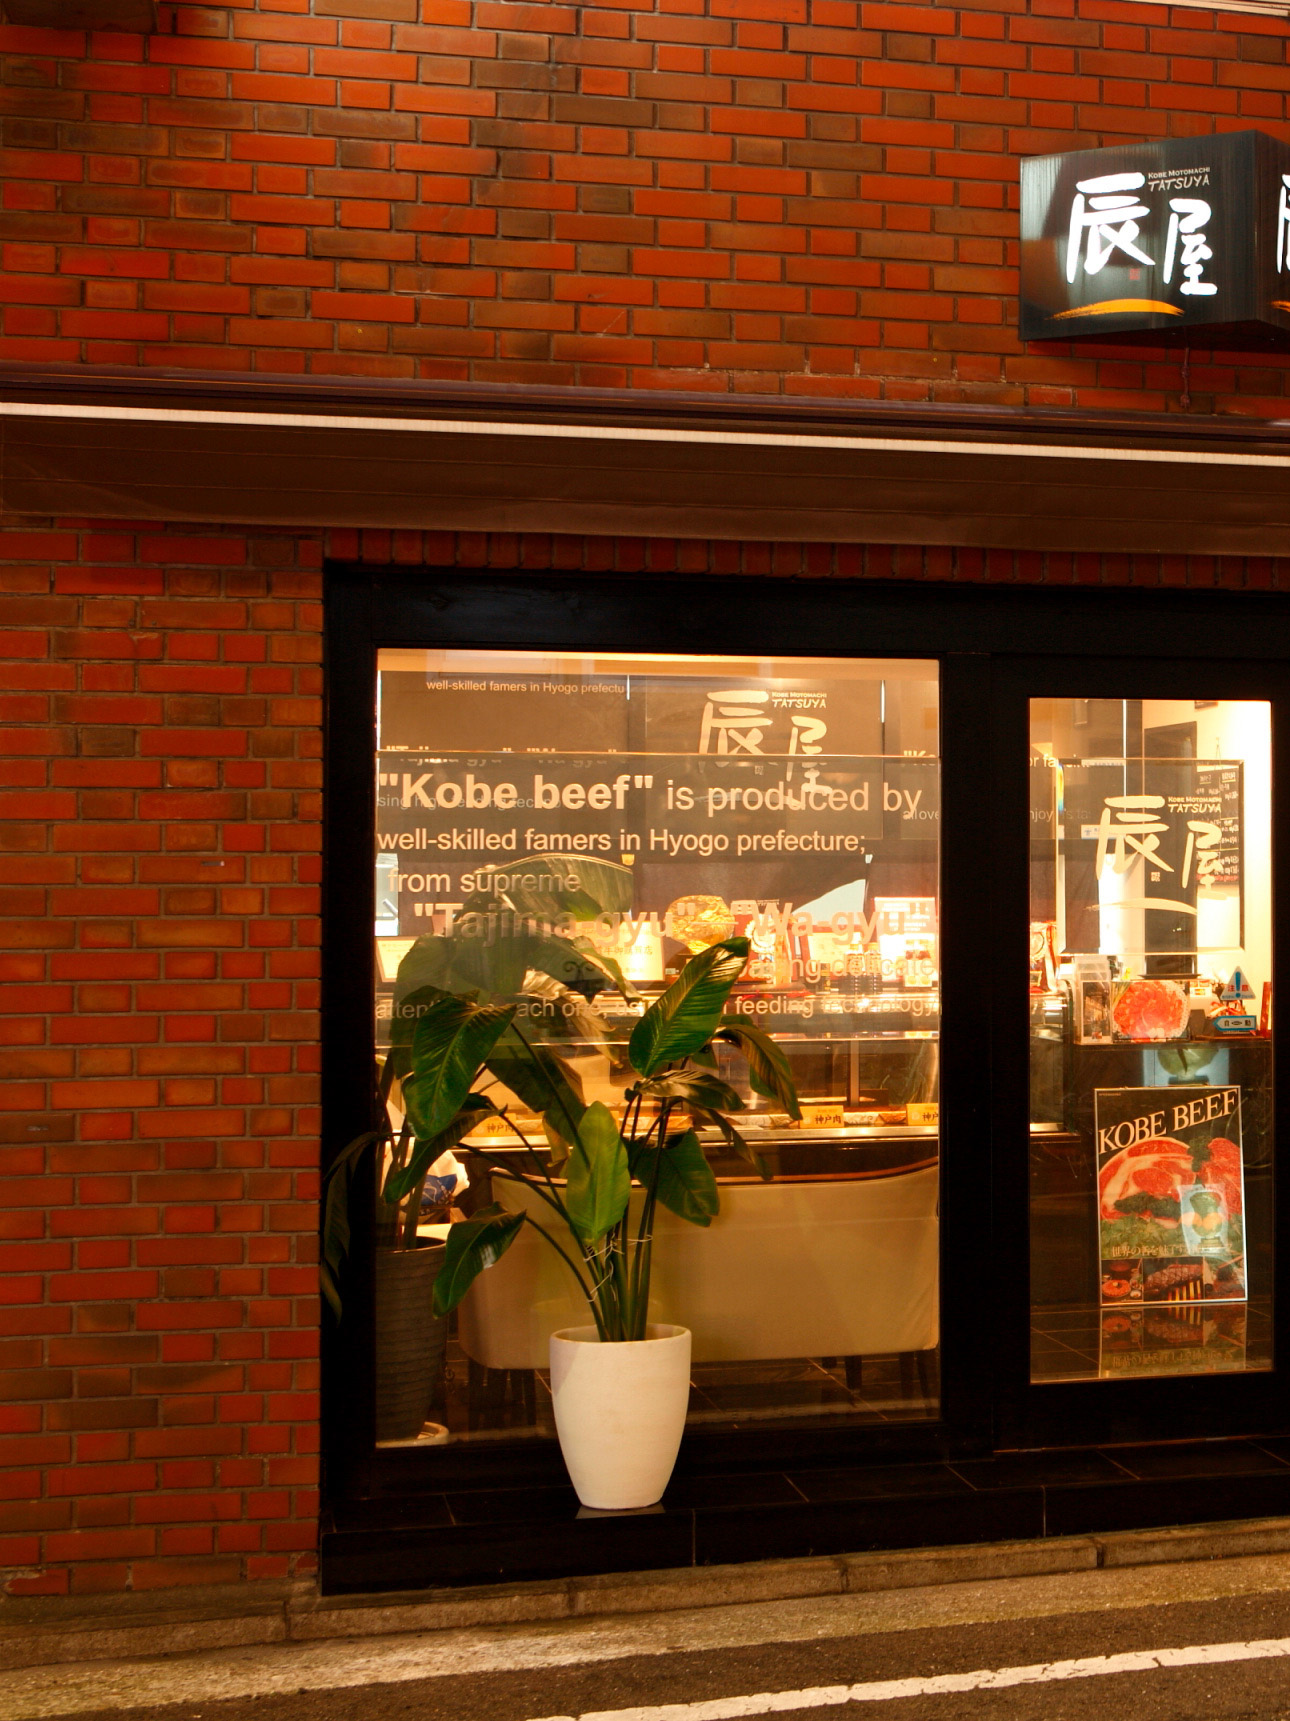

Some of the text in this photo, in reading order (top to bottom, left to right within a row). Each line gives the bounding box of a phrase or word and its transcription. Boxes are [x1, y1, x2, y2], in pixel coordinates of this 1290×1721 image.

[1168, 167, 1210, 177] MOTOMACHI
[1148, 174, 1210, 192] TATSUYA
[1066, 172, 1218, 296] 辰屋
[426, 681, 486, 692] well-skilled
[490, 681, 527, 692] famers
[530, 682, 540, 692] in
[543, 682, 578, 695] Hyogo
[772, 698, 827, 709] TATSUYA
[379, 773, 518, 810] "Kobe
[534, 773, 653, 810] beef"
[667, 779, 695, 810] is
[708, 781, 869, 817] produced
[883, 782, 922, 819] by
[1168, 803, 1222, 814] TATSUYA
[377, 828, 867, 858] well-skilled famers in Hyogo prefecture;
[388, 868, 582, 898] from supreme
[516, 999, 555, 1017] ach
[735, 996, 814, 1017] feeding
[1099, 1088, 1239, 1155] KOBE BEEF
